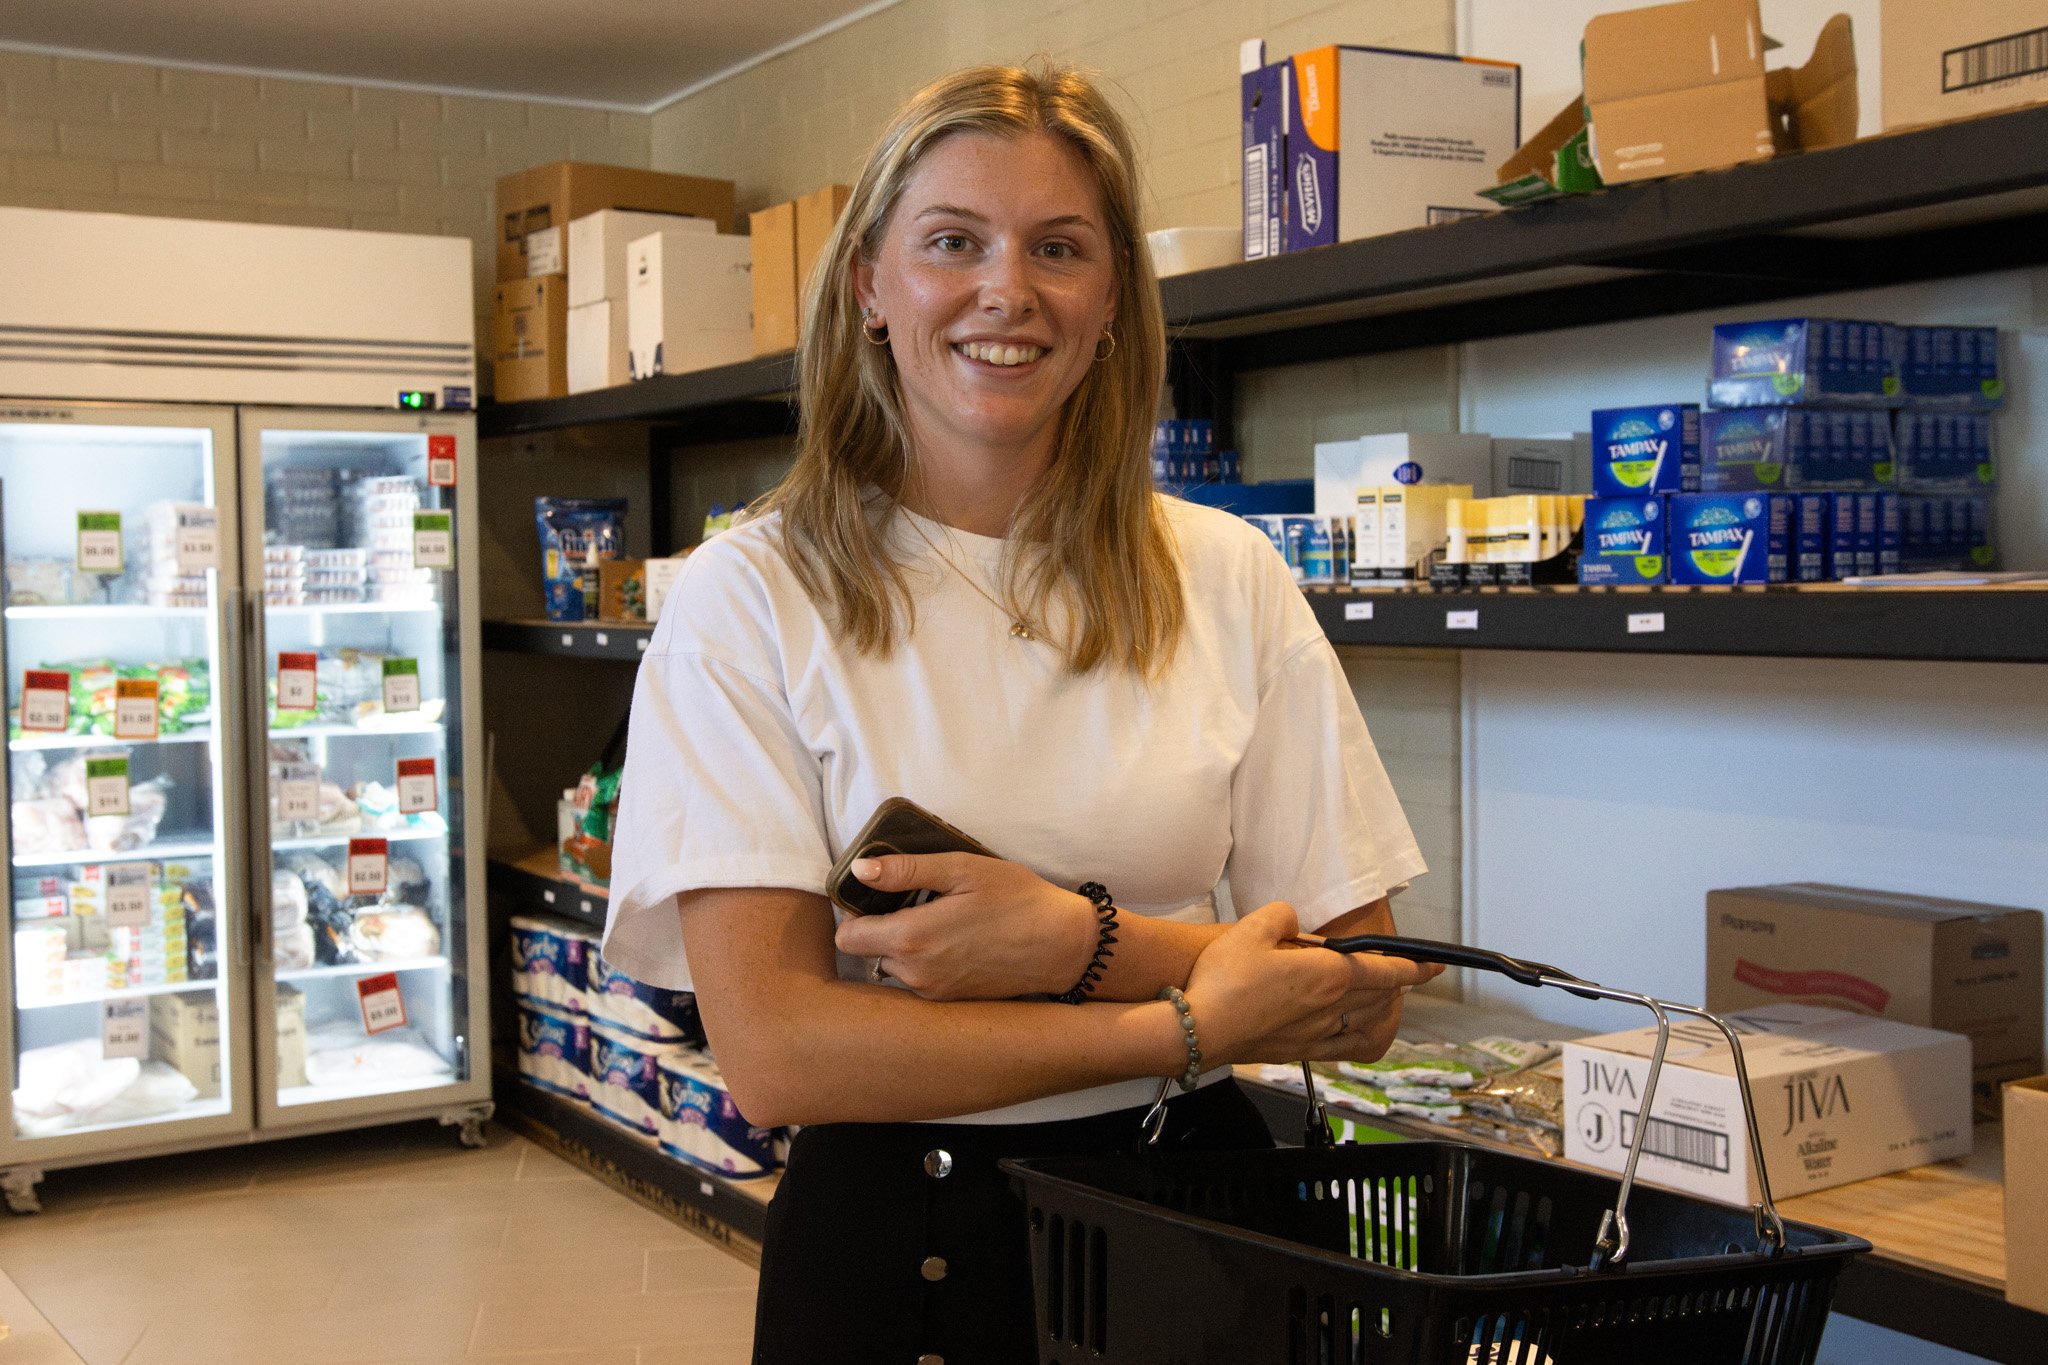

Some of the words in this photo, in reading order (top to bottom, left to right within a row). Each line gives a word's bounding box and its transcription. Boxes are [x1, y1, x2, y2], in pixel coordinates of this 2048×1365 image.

[1608, 439, 1658, 460] TAMPAX
[1598, 530, 1644, 548] TAMPAX
[1689, 527, 1745, 547] TAMPAX
[1582, 1059, 1637, 1099] JIVA
[1782, 1074, 1850, 1137] JIVA
